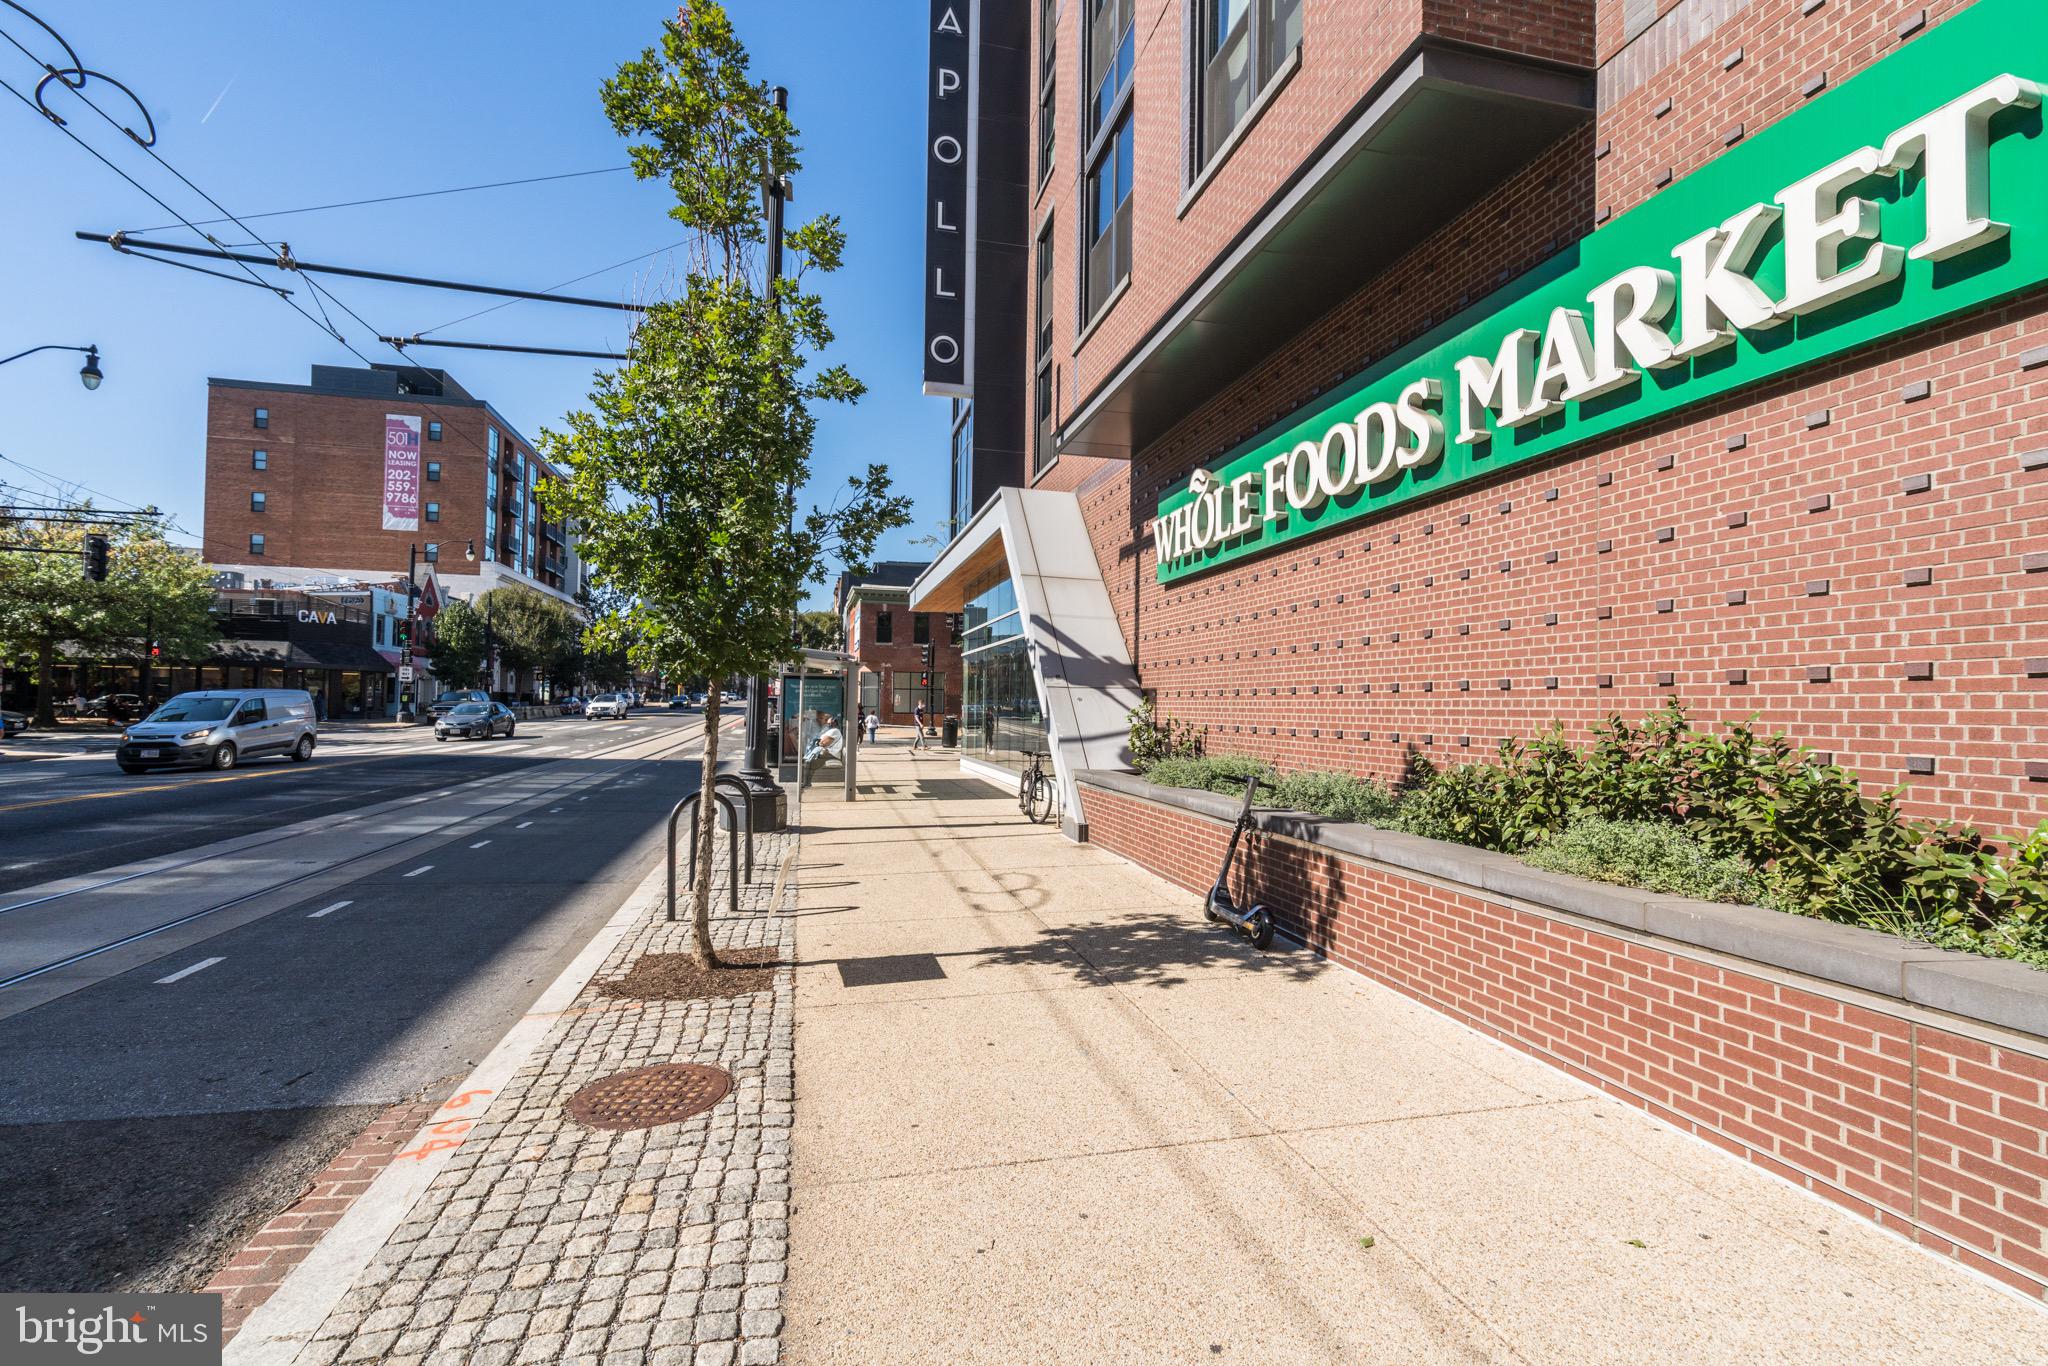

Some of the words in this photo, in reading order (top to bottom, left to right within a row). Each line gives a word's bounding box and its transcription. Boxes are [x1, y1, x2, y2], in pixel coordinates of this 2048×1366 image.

[929, 7, 962, 364] APOLLO
[1264, 377, 1445, 522] FOODS
[1454, 73, 2042, 445] MARKET
[389, 450, 417, 460] NOW
[387, 470, 416, 480] 202-
[387, 481, 416, 491] 559-
[386, 493, 417, 504] 9786
[298, 609, 337, 625] CAVA
